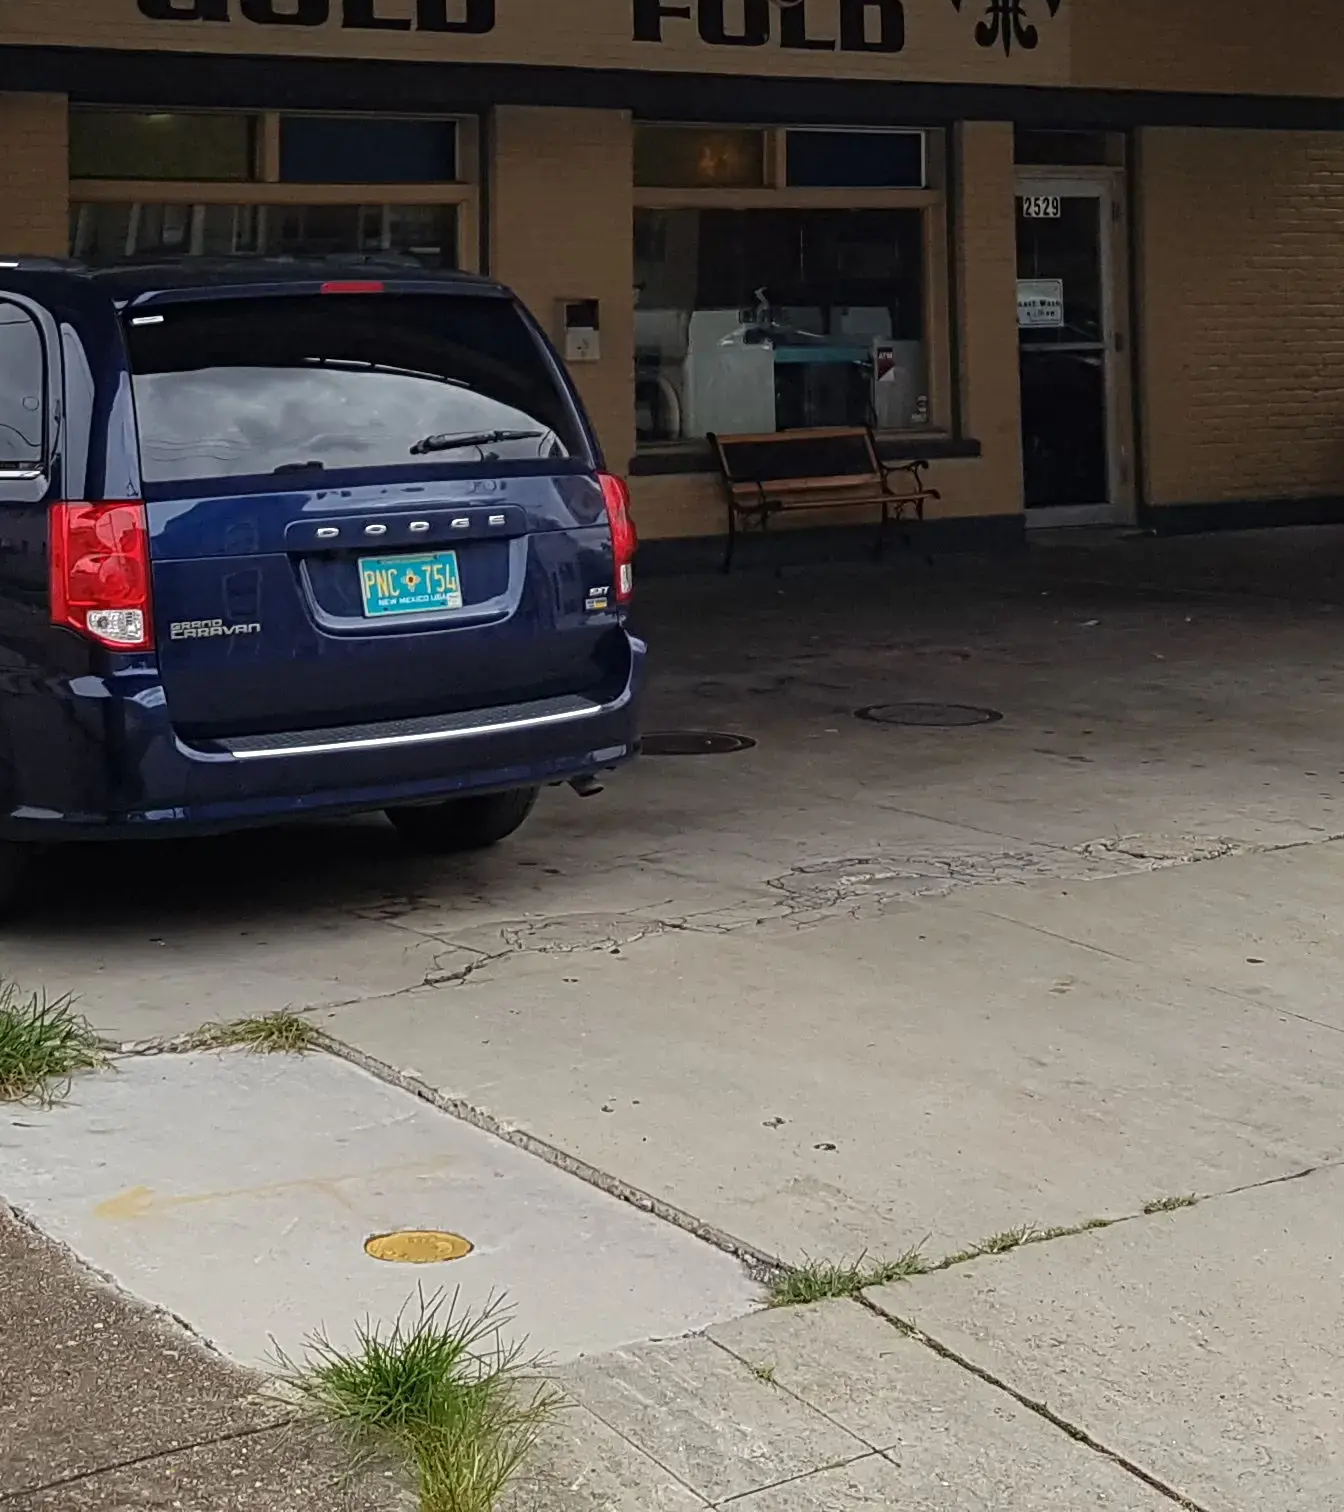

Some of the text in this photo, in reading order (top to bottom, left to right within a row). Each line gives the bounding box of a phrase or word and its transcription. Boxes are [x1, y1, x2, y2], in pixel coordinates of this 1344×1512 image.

[1024, 197, 1059, 216] 2529
[315, 514, 507, 539] DODGE
[364, 563, 458, 599] PNC 754
[378, 598, 398, 606] NEW
[399, 594, 430, 604] MEXICO
[170, 619, 223, 631] GRAND
[170, 623, 261, 640] CARAVAN
